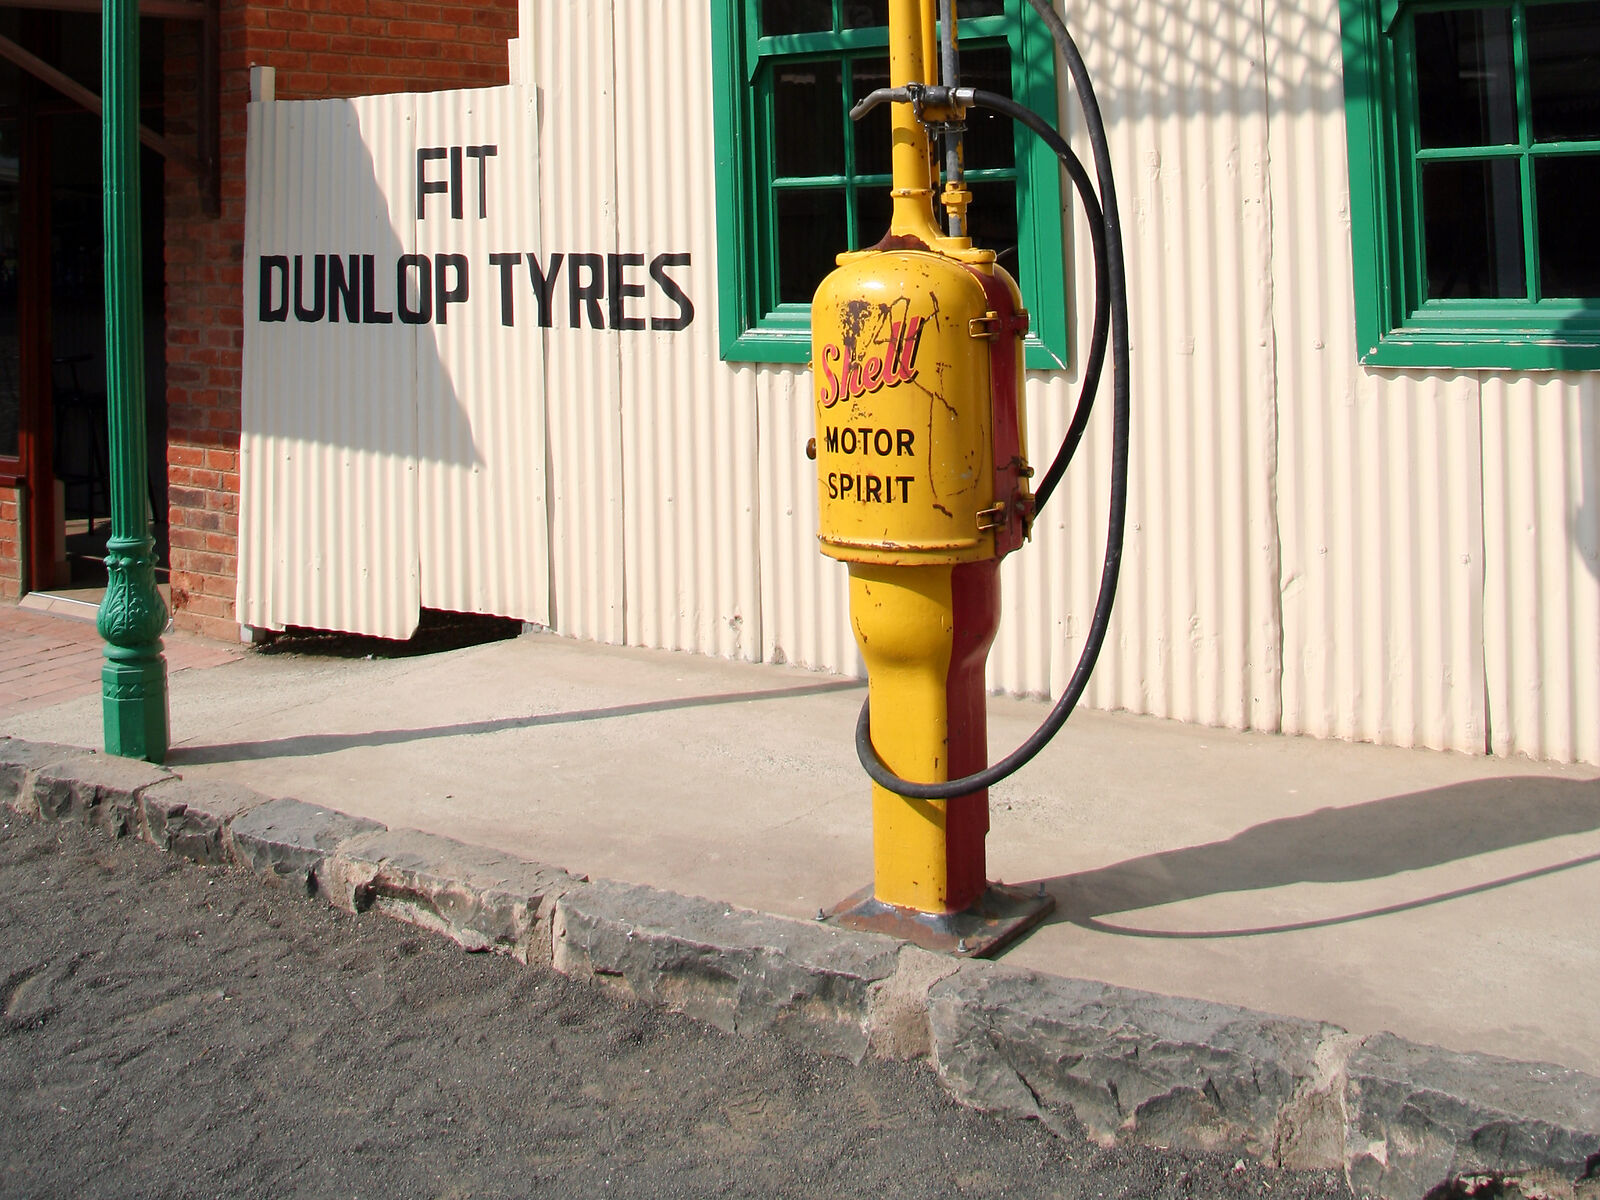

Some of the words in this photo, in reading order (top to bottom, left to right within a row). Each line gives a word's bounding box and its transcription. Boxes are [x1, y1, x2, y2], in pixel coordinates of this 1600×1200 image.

[417, 145, 497, 220] FIT
[259, 253, 469, 324] DUNLOP
[489, 252, 695, 331] TYRES
[820, 315, 925, 409] Shell
[825, 425, 915, 457] MOTOR
[828, 472, 915, 503] SPIRIT
